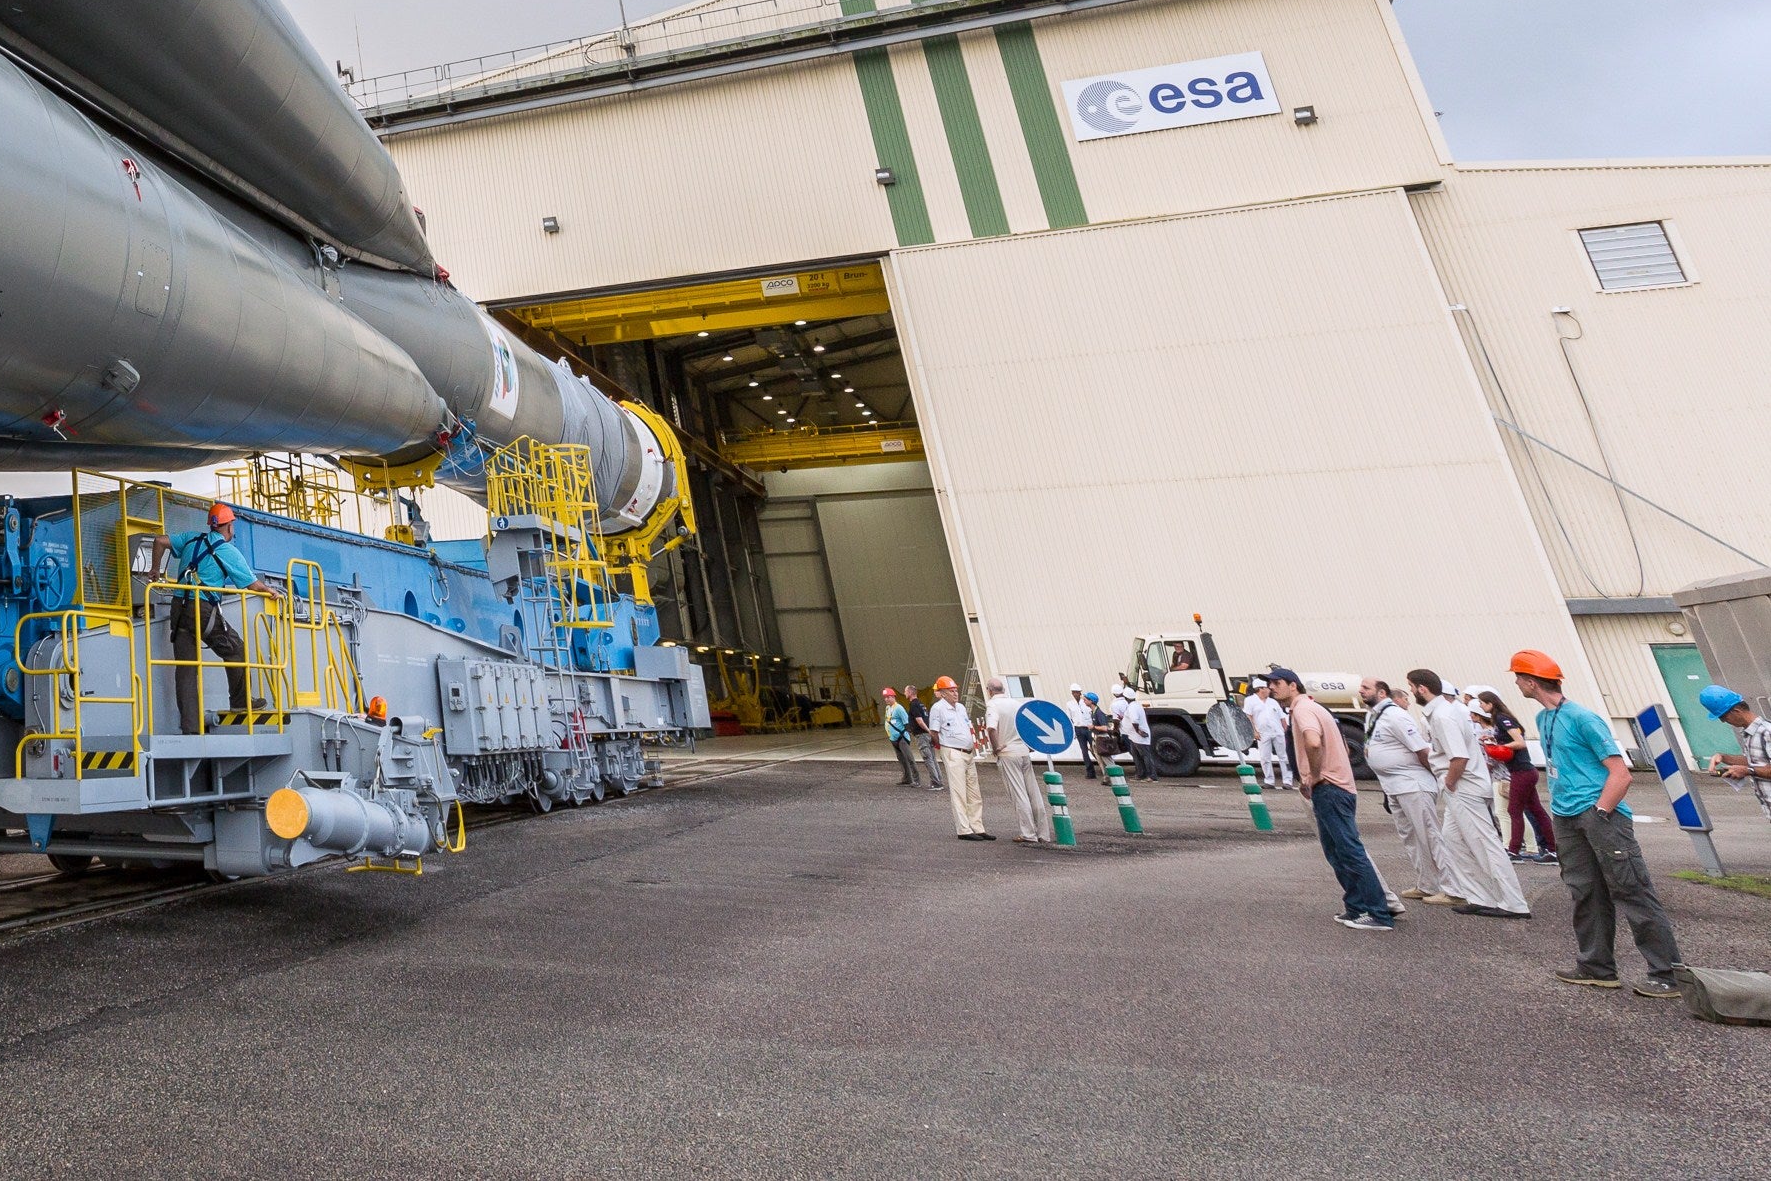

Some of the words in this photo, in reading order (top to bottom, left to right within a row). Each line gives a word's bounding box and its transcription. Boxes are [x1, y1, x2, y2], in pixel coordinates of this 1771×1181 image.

[1148, 71, 1265, 114] esa
[809, 273, 819, 281] 20
[1321, 681, 1346, 691] esa
